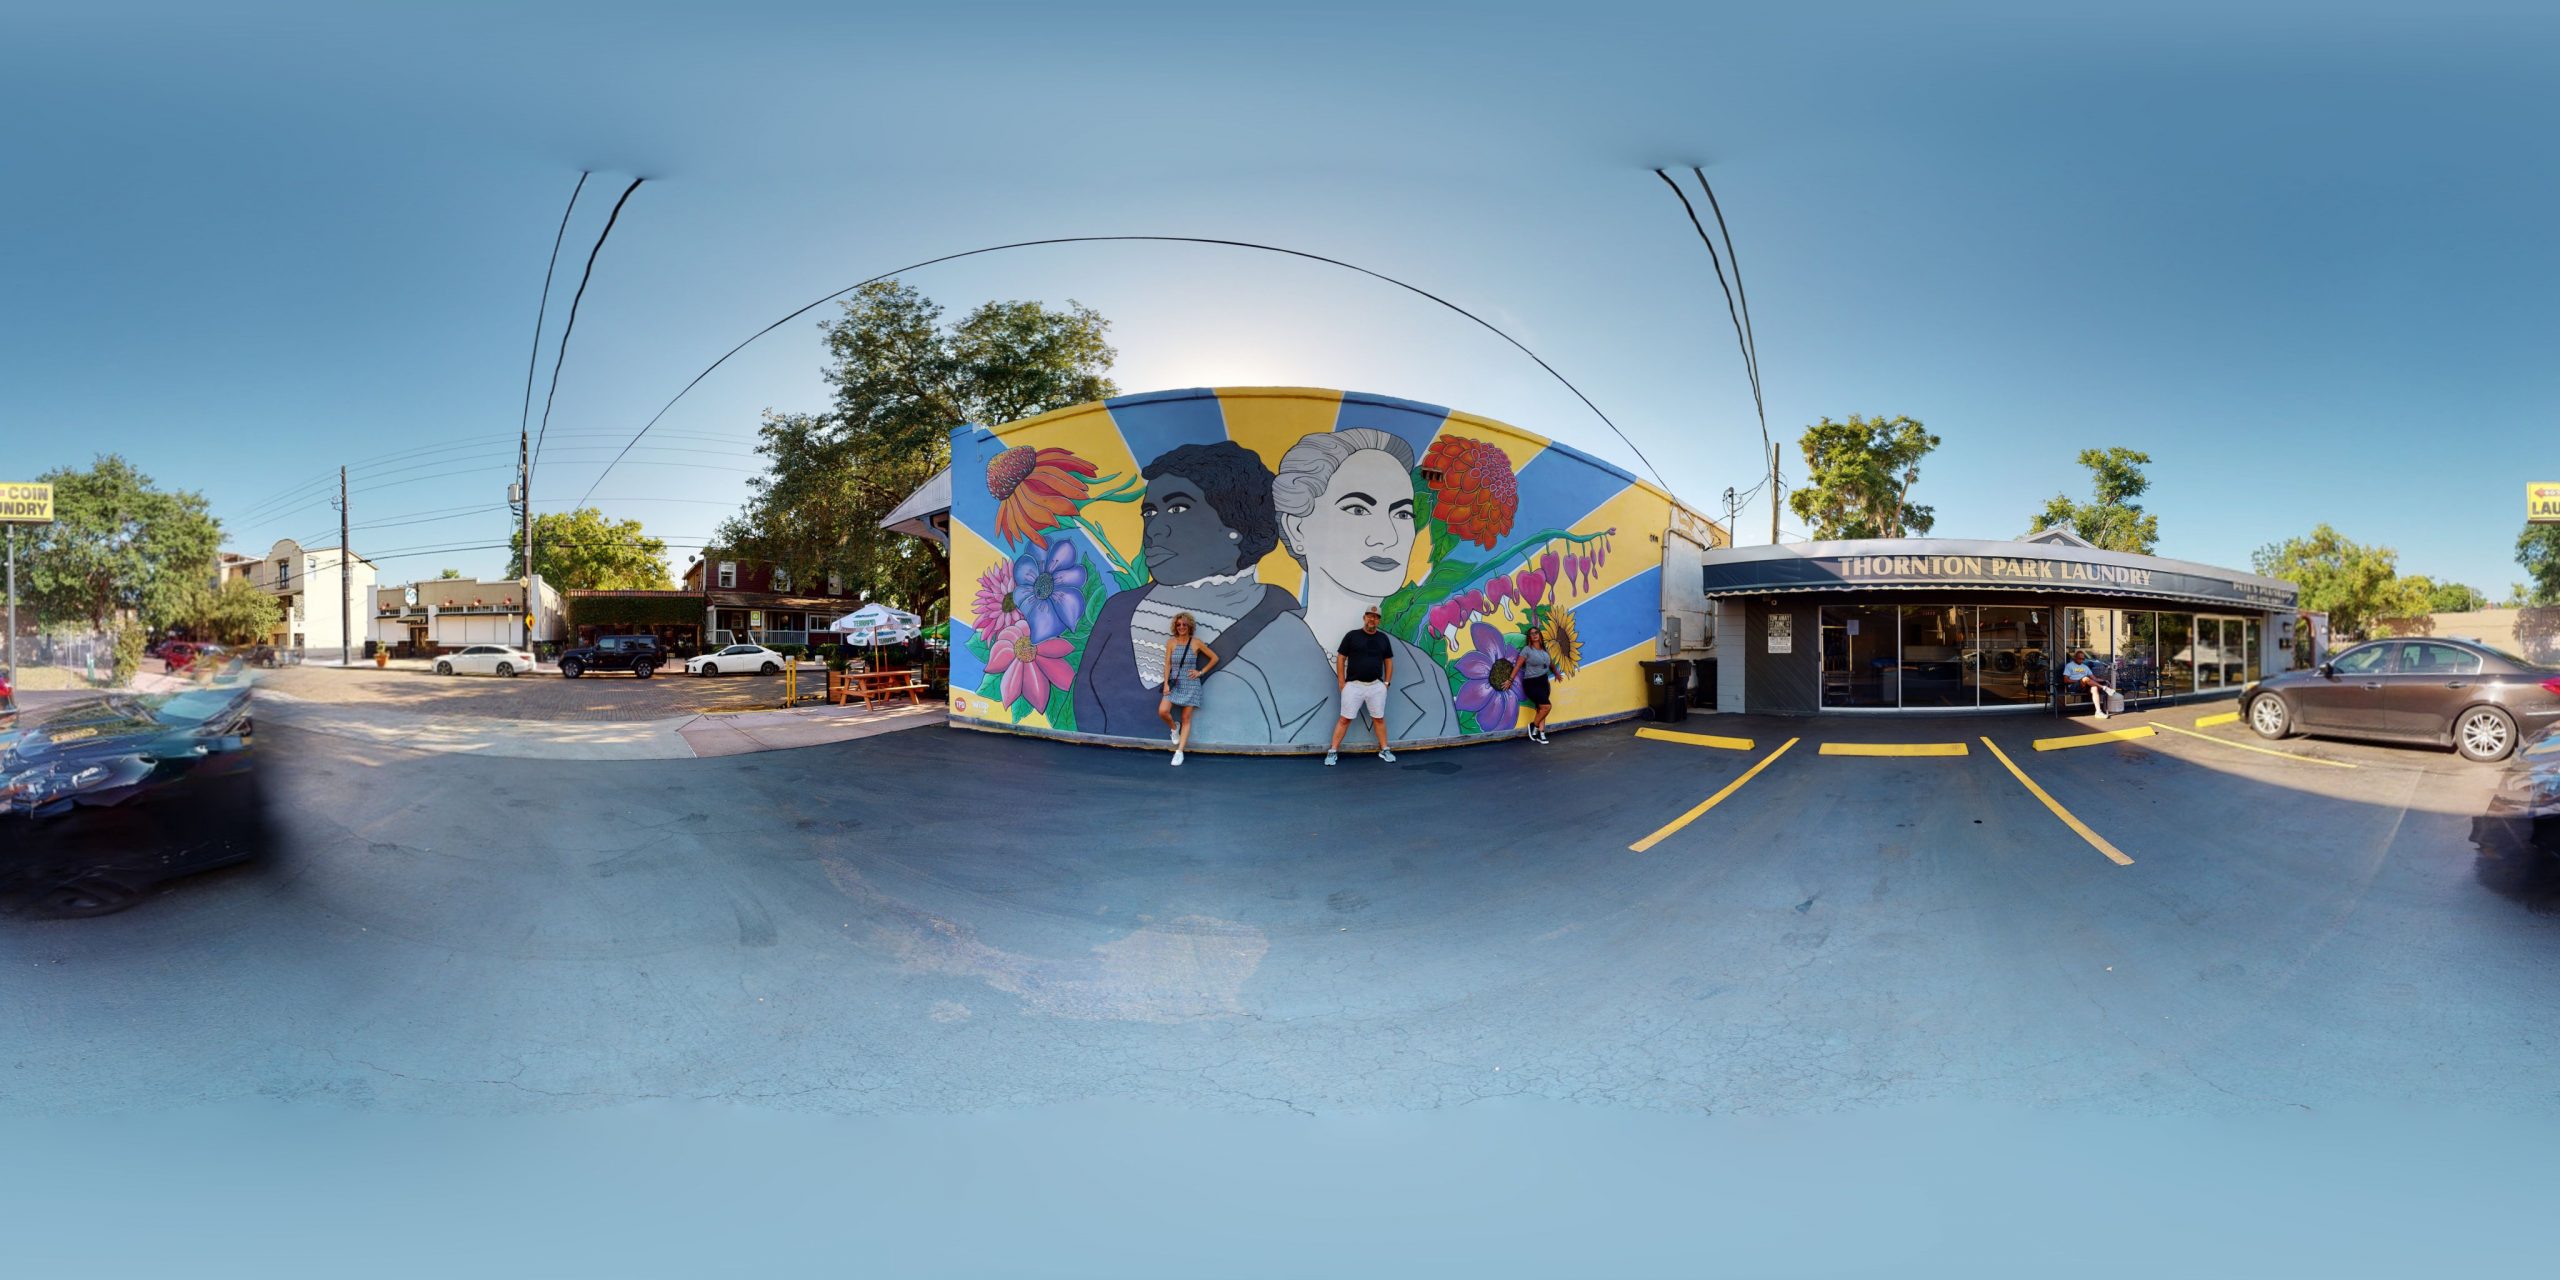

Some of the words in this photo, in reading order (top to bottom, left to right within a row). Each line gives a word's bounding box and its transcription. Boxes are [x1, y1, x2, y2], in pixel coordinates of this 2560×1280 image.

[8, 486, 48, 500] COIN
[0, 502, 47, 515] NDRY
[1838, 556, 1982, 576] THORNTON
[1992, 557, 2053, 578] PARK
[2061, 562, 2151, 586] LAUNDRY
